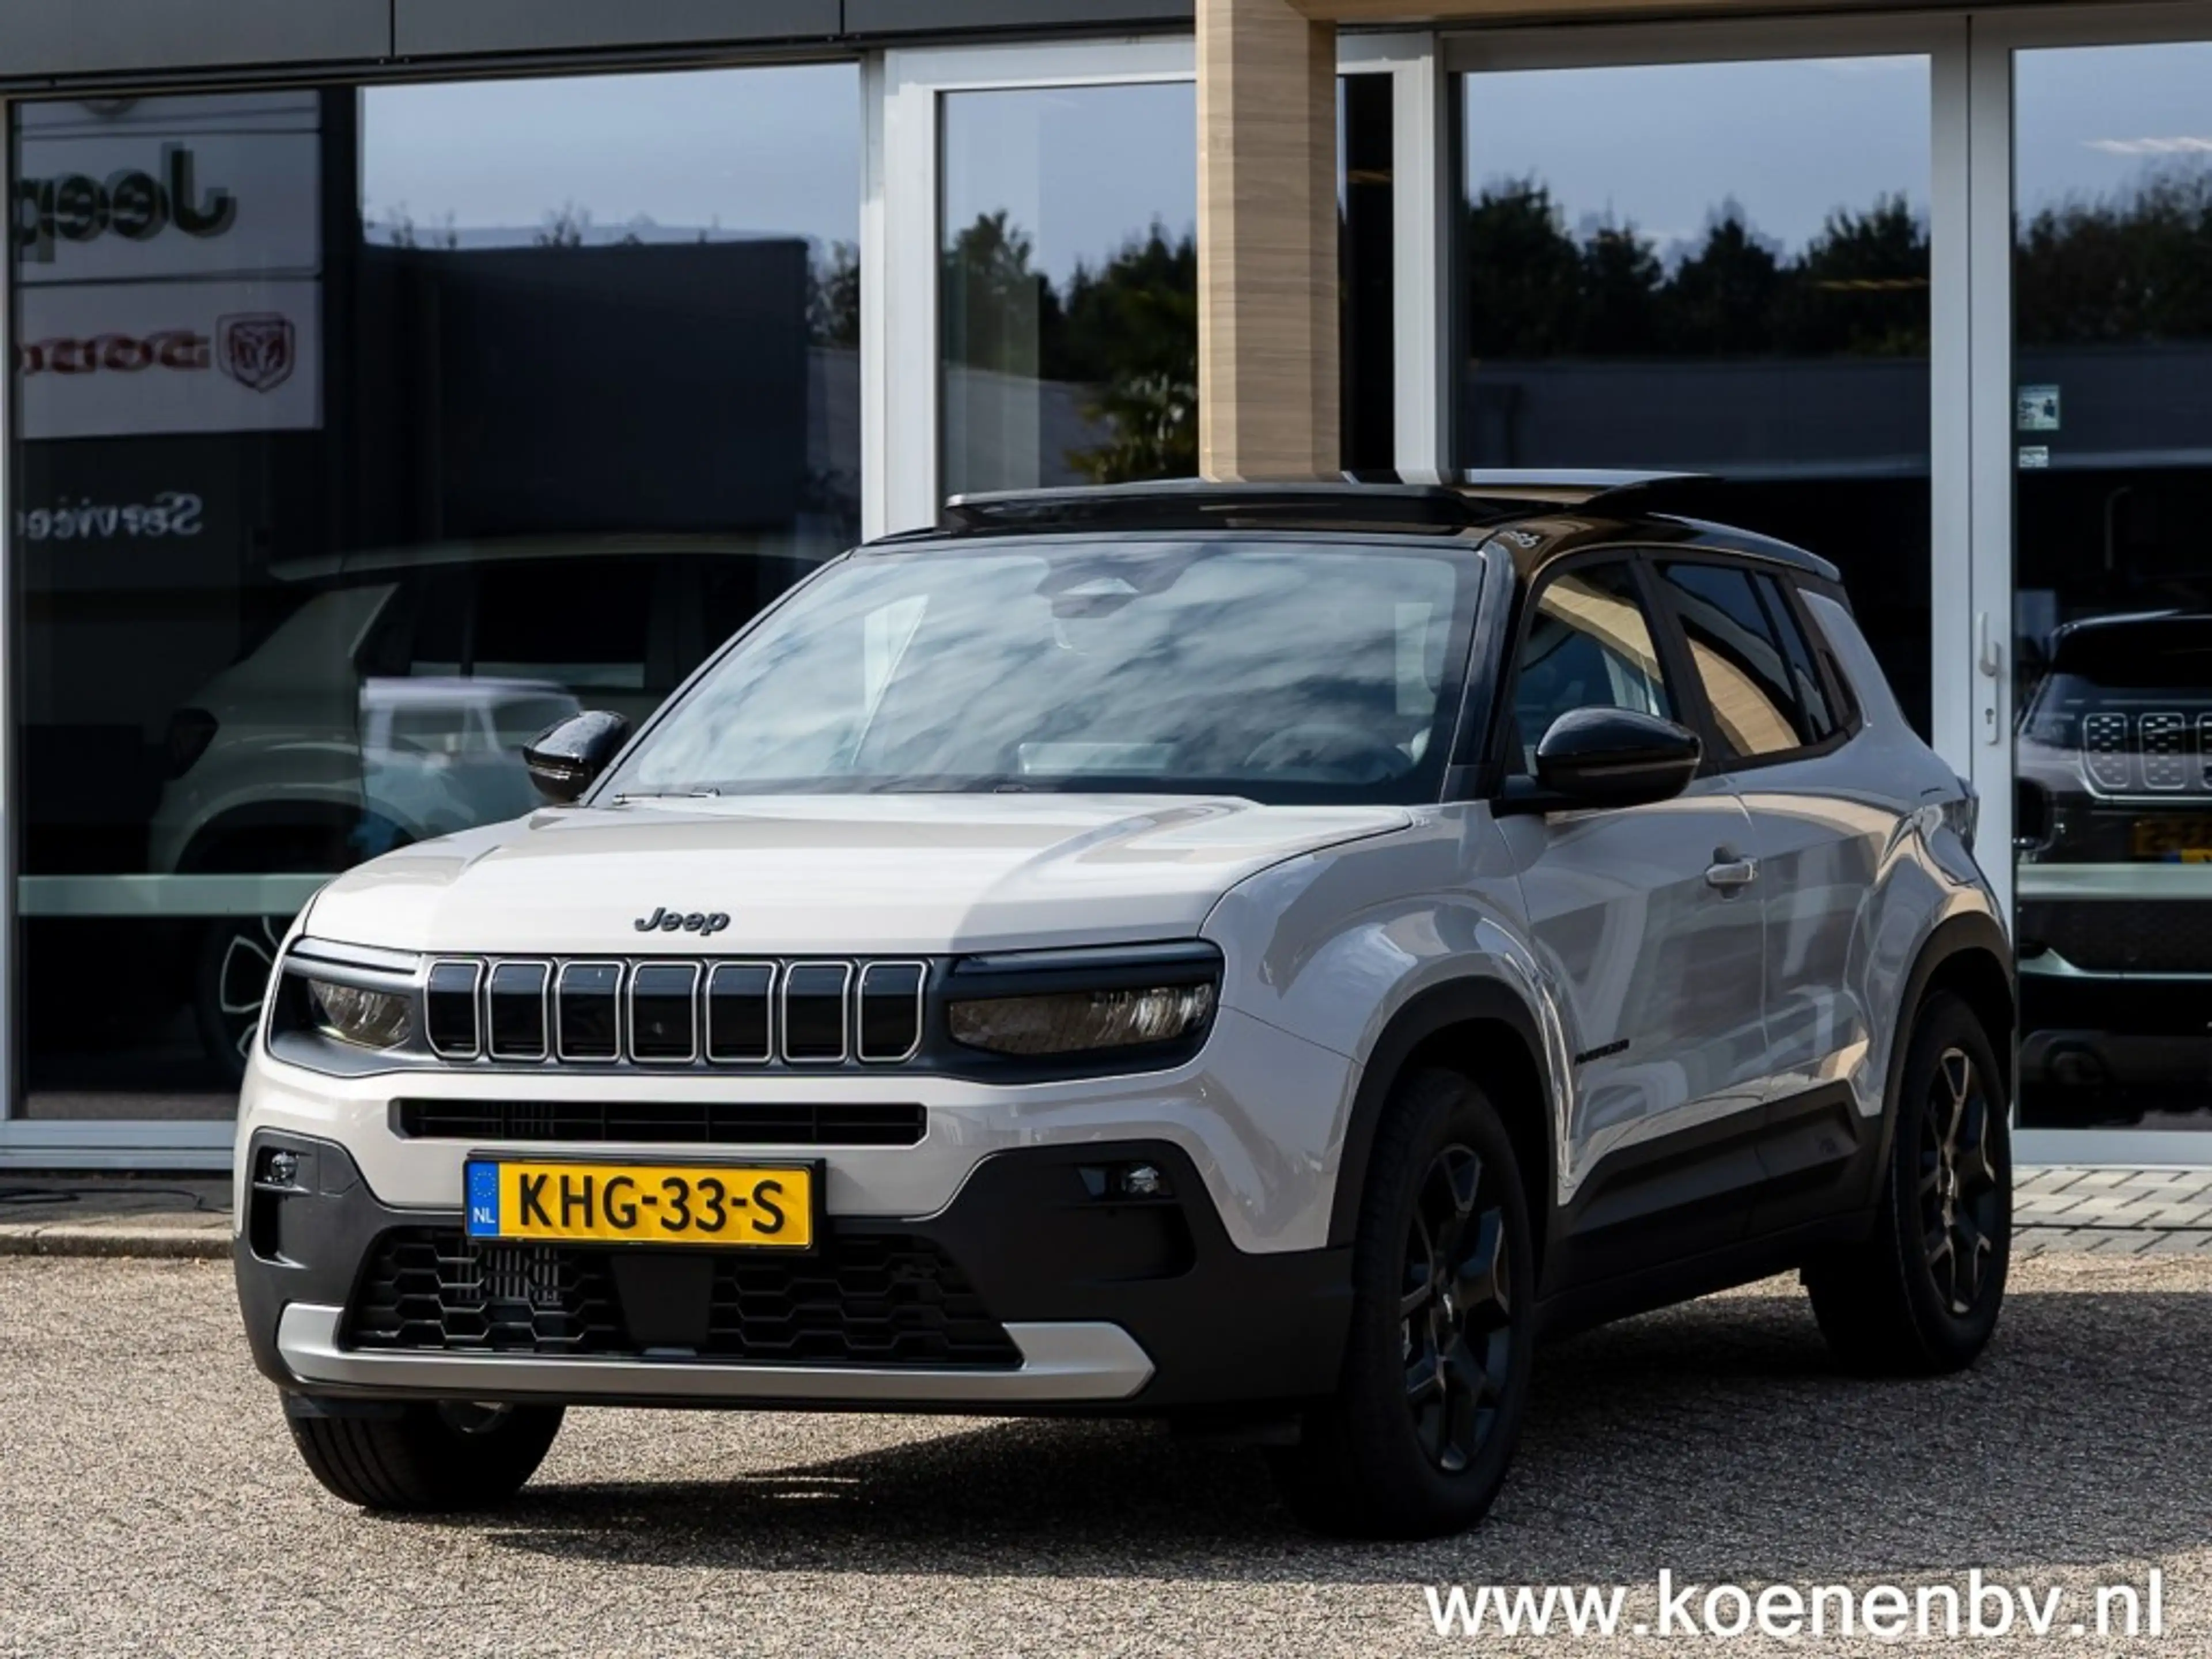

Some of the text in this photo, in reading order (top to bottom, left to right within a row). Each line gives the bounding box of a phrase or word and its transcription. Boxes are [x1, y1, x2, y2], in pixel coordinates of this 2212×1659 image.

[635, 907, 730, 936] Jeep
[473, 1208, 495, 1225] NL
[520, 1173, 785, 1234] KHG-33-S
